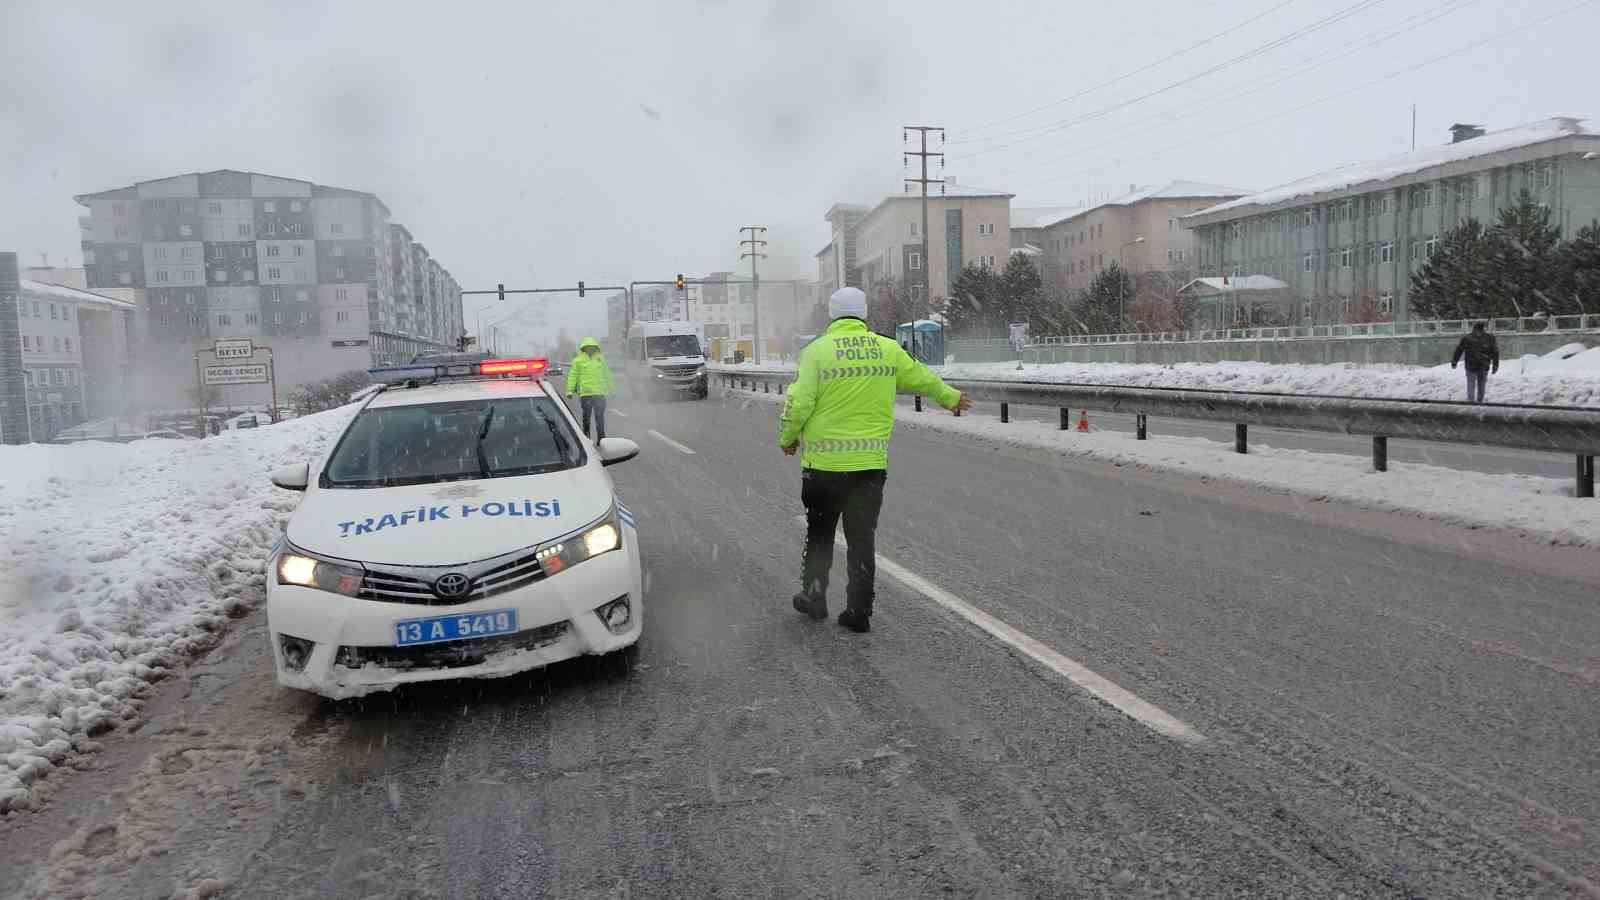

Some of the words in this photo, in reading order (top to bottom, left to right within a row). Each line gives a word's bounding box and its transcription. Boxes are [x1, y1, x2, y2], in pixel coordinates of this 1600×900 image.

[836, 348, 883, 361] POLİSİ
[338, 506, 451, 538] TRAFİK
[398, 625, 422, 642] 13
[430, 622, 446, 638] A
[458, 612, 510, 635] 5419
